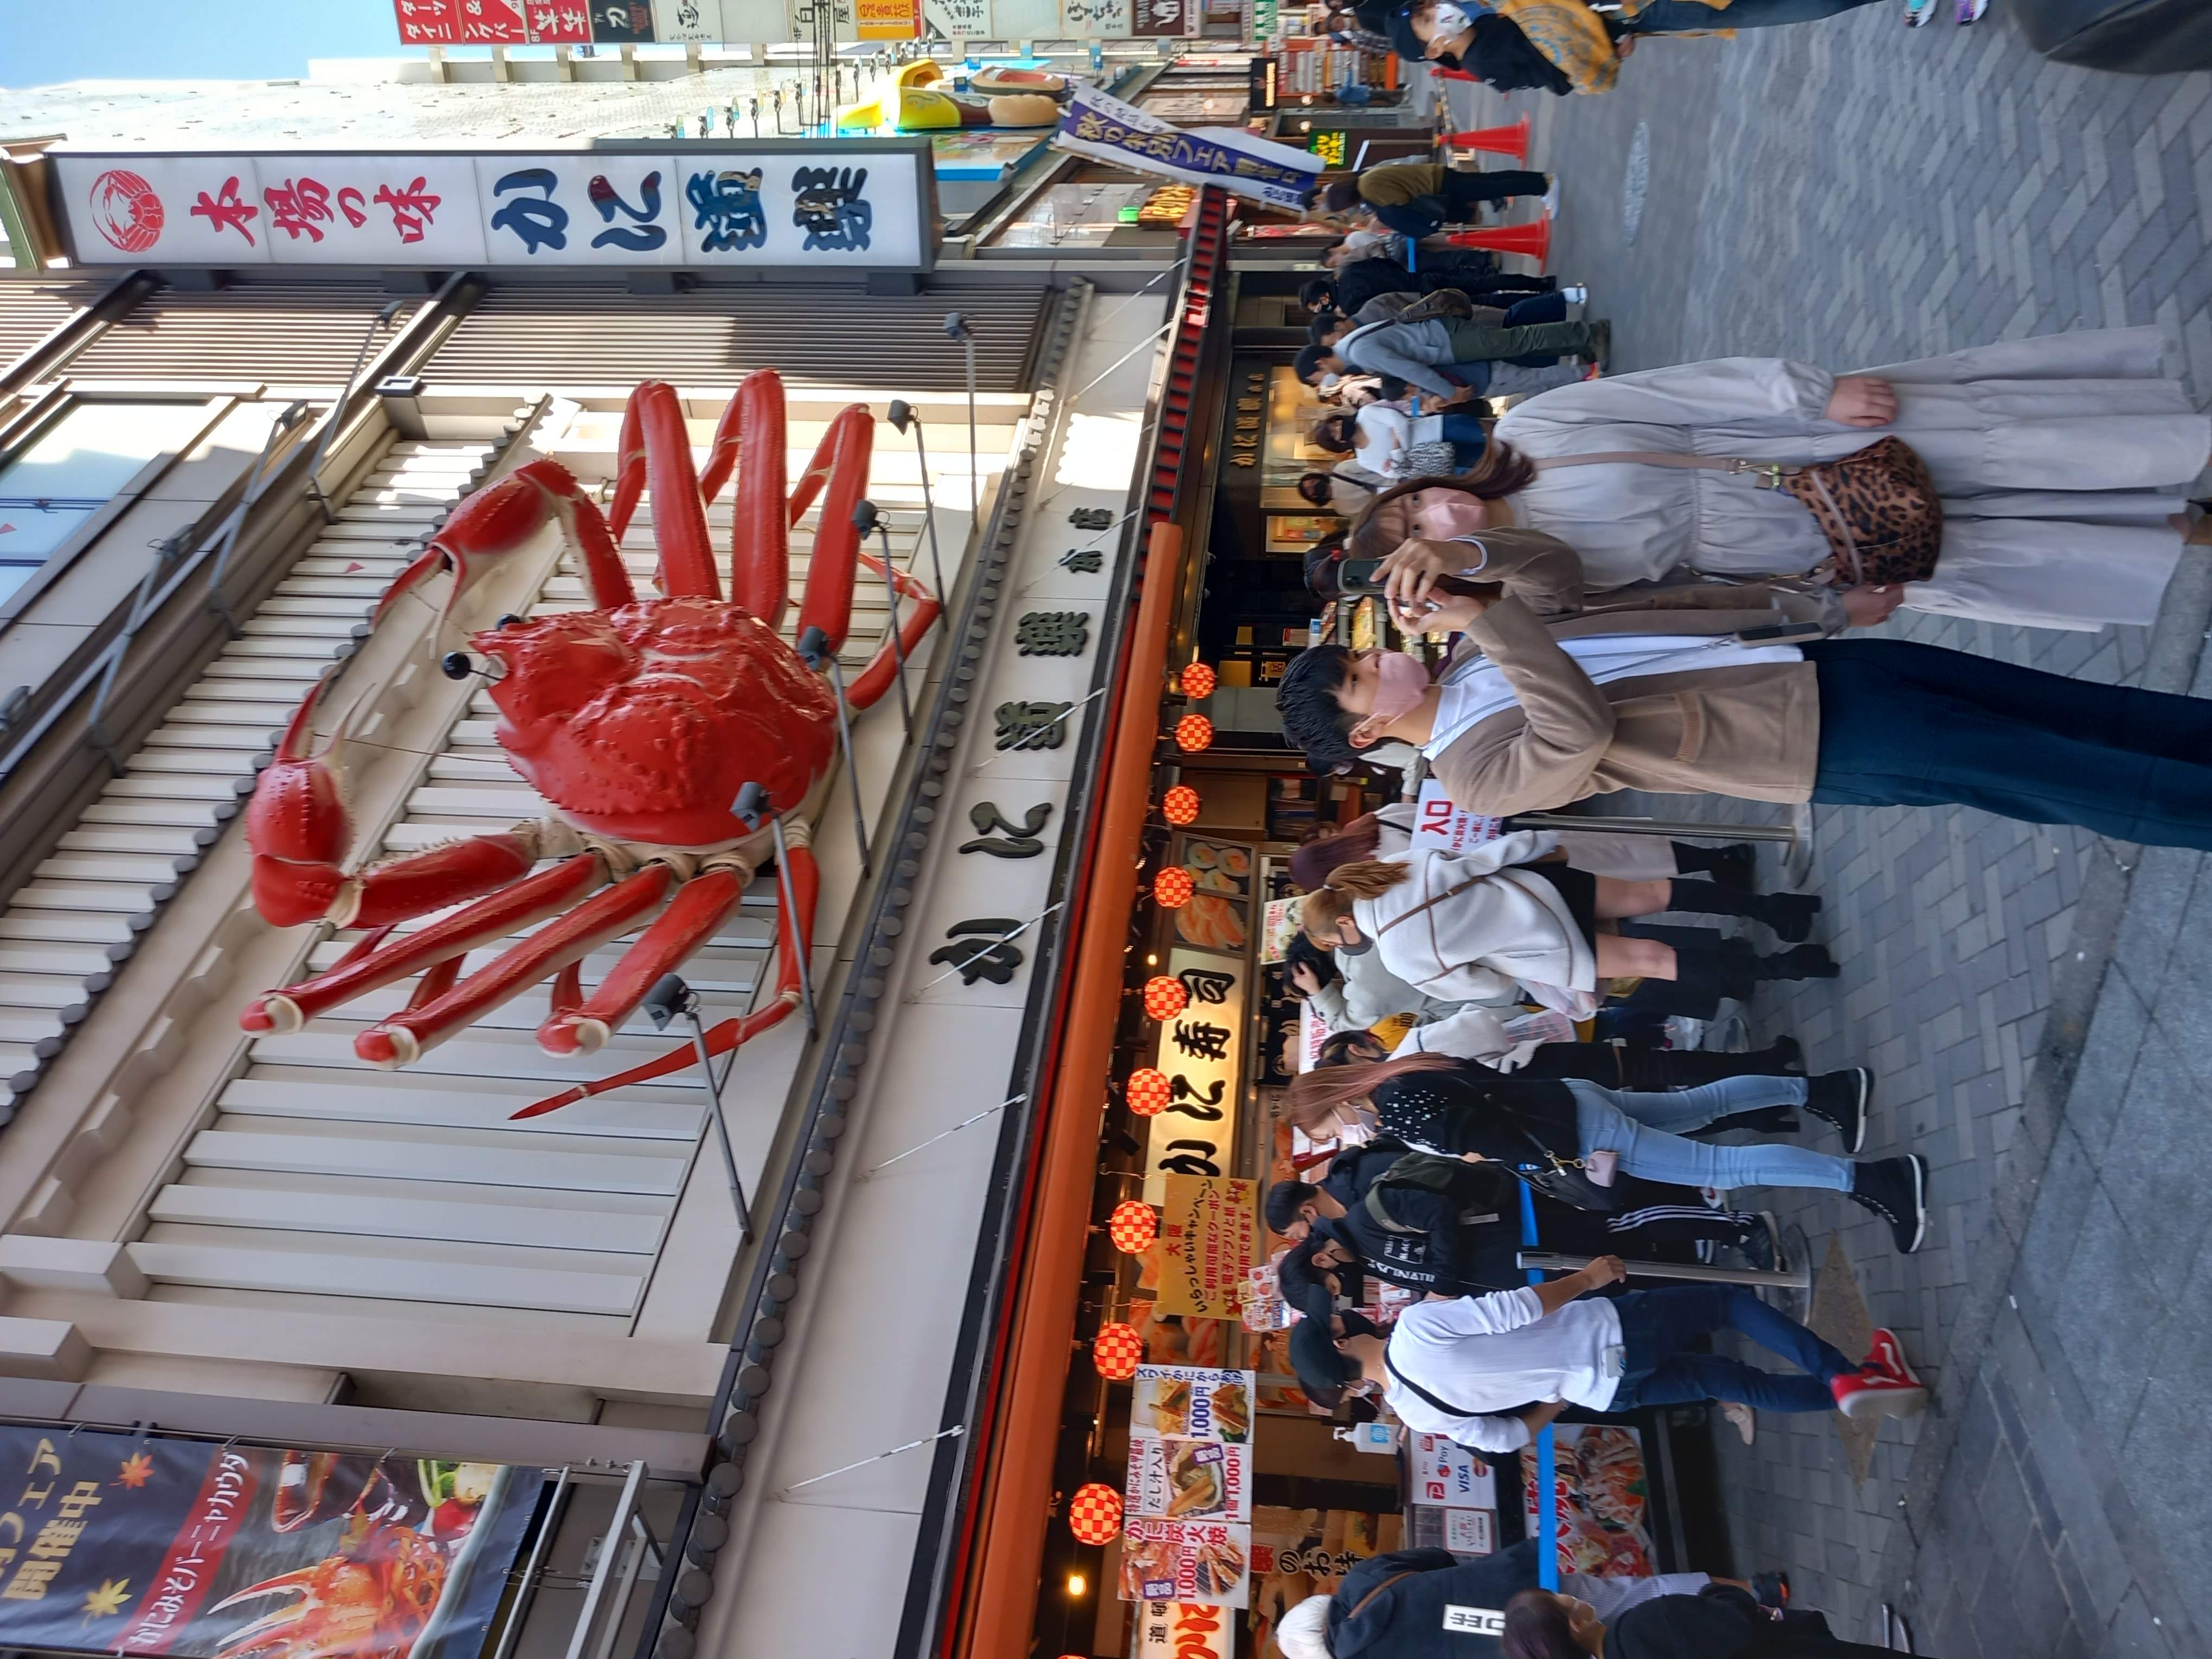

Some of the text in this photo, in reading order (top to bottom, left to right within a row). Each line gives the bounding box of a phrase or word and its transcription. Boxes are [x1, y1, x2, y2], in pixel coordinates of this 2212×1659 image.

[405, 23, 525, 40] ダイニングバー
[511, 0, 519, 9] 9
[859, 3, 910, 17] 鳥貴族
[530, 29, 541, 42] 8F
[190, 176, 441, 248] 本場の味
[491, 167, 873, 255] かに道楽
[1420, 800, 1453, 835] 入口
[1158, 968, 1235, 1177] かに寿司
[1166, 1224, 1181, 1256] 大阪
[1184, 1179, 1212, 1313] いらっしゃいキャンペーン
[1204, 1189, 1220, 1301] ご利用可能なクーポン
[1221, 1206, 1235, 1285] 電子アプリと紙
[1238, 1206, 1252, 1279] 利用できます。
[1189, 1386, 1212, 1438] 1,000円
[1128, 1439, 1146, 1513] 特選かにみそ甲羅焼
[1147, 1447, 1163, 1508] だし汁入り
[1438, 1445, 1450, 1463] Pay
[1458, 1465, 1470, 1493] VISA
[2, 1481, 103, 1599] 開催中
[128, 1451, 249, 1644] かにみそバーニャカウダ
[1125, 1521, 1227, 1546] かに炭火焼
[1177, 1546, 1197, 1599] 1,000円
